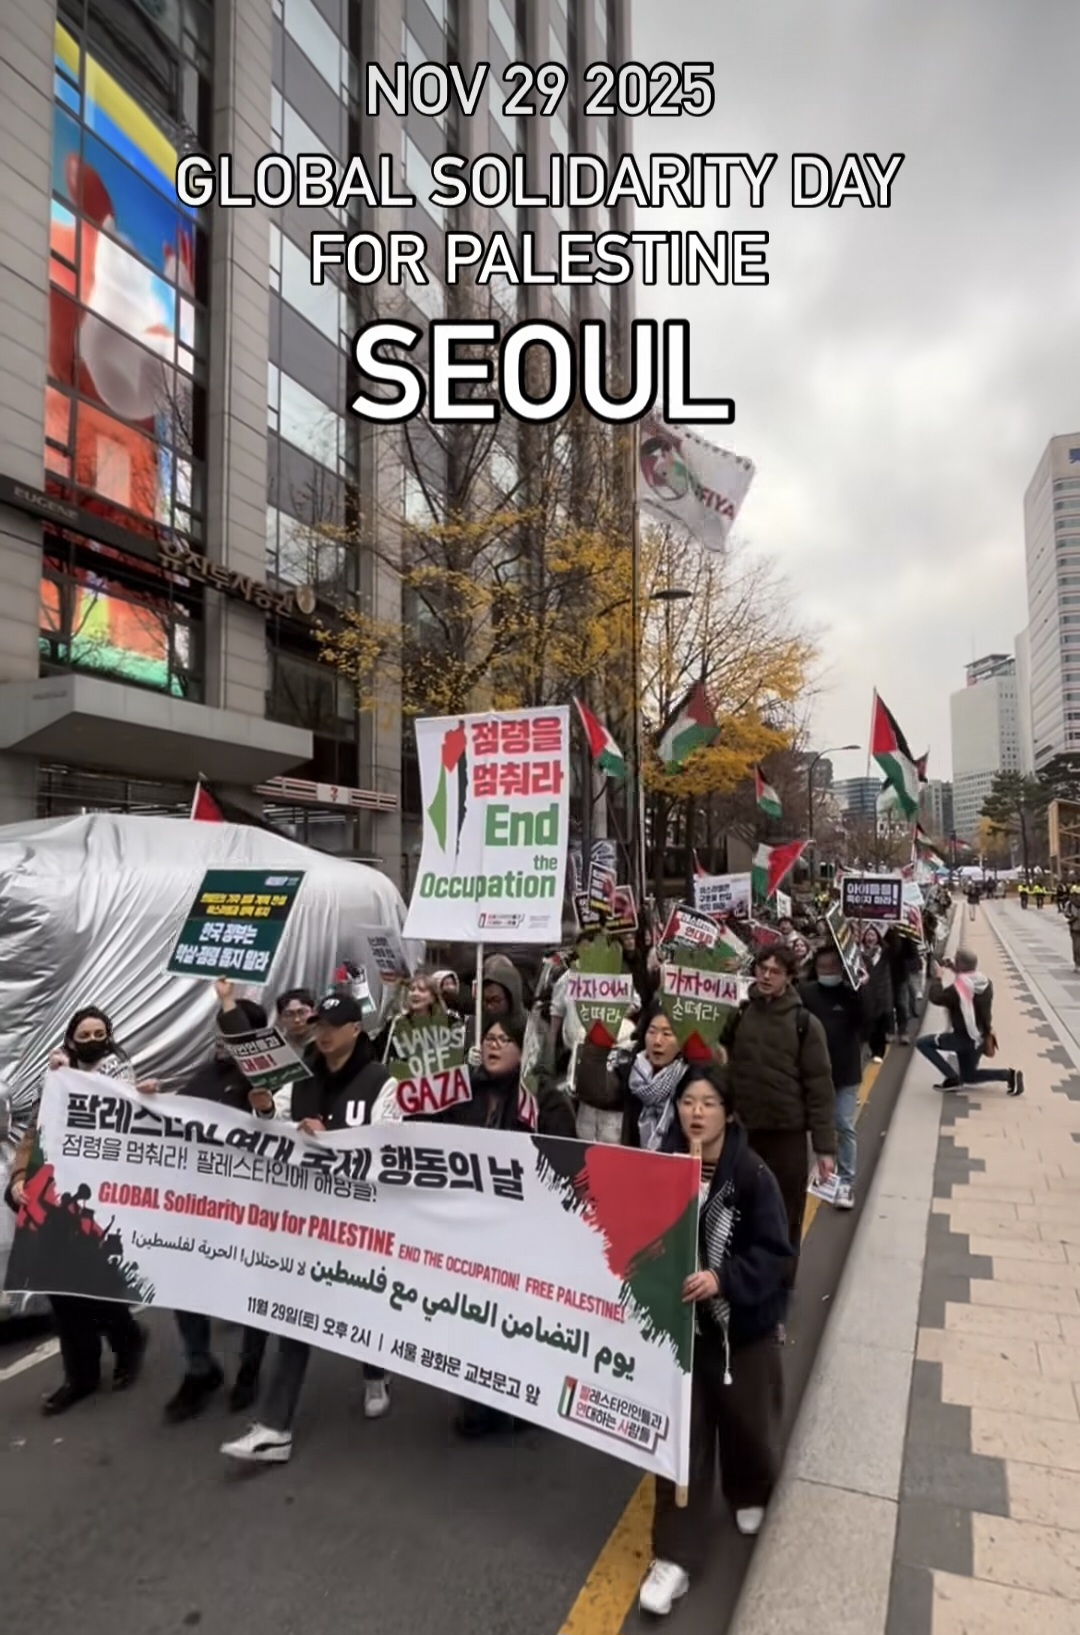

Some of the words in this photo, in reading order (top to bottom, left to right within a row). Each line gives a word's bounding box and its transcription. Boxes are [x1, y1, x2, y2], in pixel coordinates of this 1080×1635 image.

[157, 540, 296, 618] 유진투자증권
[471, 716, 562, 756] 점령을
[473, 759, 564, 797] 멈춰라
[485, 803, 559, 846] End
[533, 855, 558, 871] the
[419, 870, 557, 902] Occupation
[393, 1026, 464, 1058] HANDS
[408, 1046, 450, 1077] OFF
[396, 1068, 470, 1114] GAZA
[62, 1133, 122, 1162] 점령을
[126, 1140, 188, 1170] 멈춰라!
[196, 1149, 309, 1191] 팔레스타인에
[378, 1145, 484, 1193] 행동의
[488, 1156, 524, 1201] 날
[98, 1181, 160, 1210] GLOBAL
[163, 1190, 245, 1225] Solidarity
[247, 1204, 281, 1232] Day
[281, 1210, 307, 1236] for
[308, 1215, 395, 1256] PALESTINE
[398, 1244, 421, 1263] END
[423, 1250, 444, 1269] THE
[445, 1256, 520, 1290] OCCUPATION!
[525, 1277, 554, 1299] FREE
[556, 1286, 626, 1323] PALESTINE!
[310, 1260, 388, 1294] فلسطين
[389, 1281, 418, 1311] مع
[422, 1292, 498, 1327] العالمي
[247, 1297, 269, 1316] 11월
[270, 1302, 319, 1331] 29일(토)
[322, 1318, 348, 1338] 오후
[350, 1326, 371, 1347] 2시
[390, 1339, 418, 1362] 서울
[420, 1347, 462, 1378] 광화문
[463, 1362, 522, 1398] 교보문고
[525, 1384, 541, 1405] 앞
[502, 1313, 590, 1357] التضامن
[594, 1347, 636, 1381] يوم
[576, 1402, 616, 1430] 연대하는
